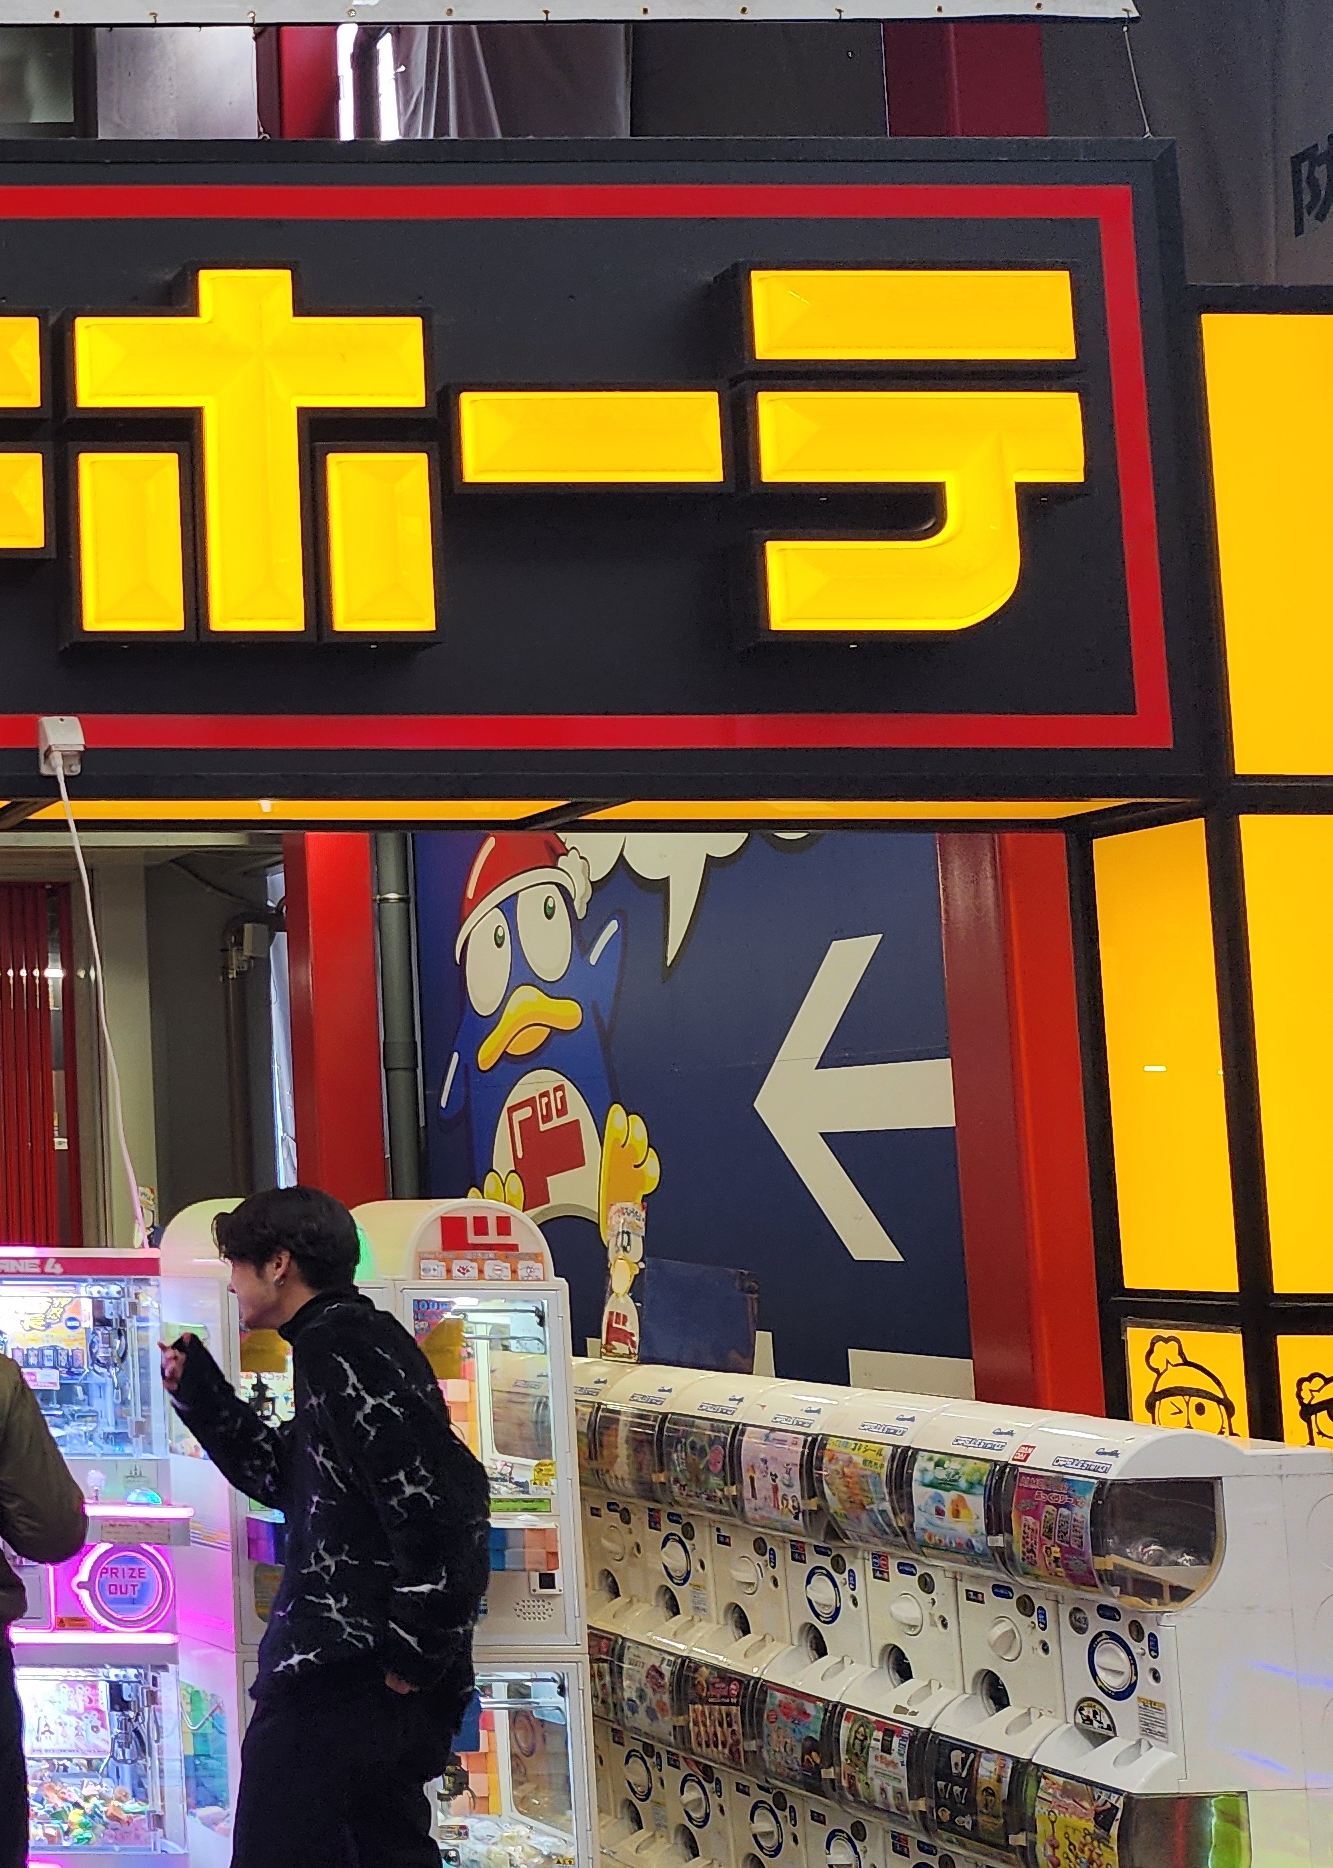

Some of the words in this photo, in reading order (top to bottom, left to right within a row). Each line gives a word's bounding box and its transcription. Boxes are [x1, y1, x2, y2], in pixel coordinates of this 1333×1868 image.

[44, 1257, 64, 1274] 4
[100, 1565, 147, 1579] PRIZE
[108, 1582, 139, 1596] OUT
